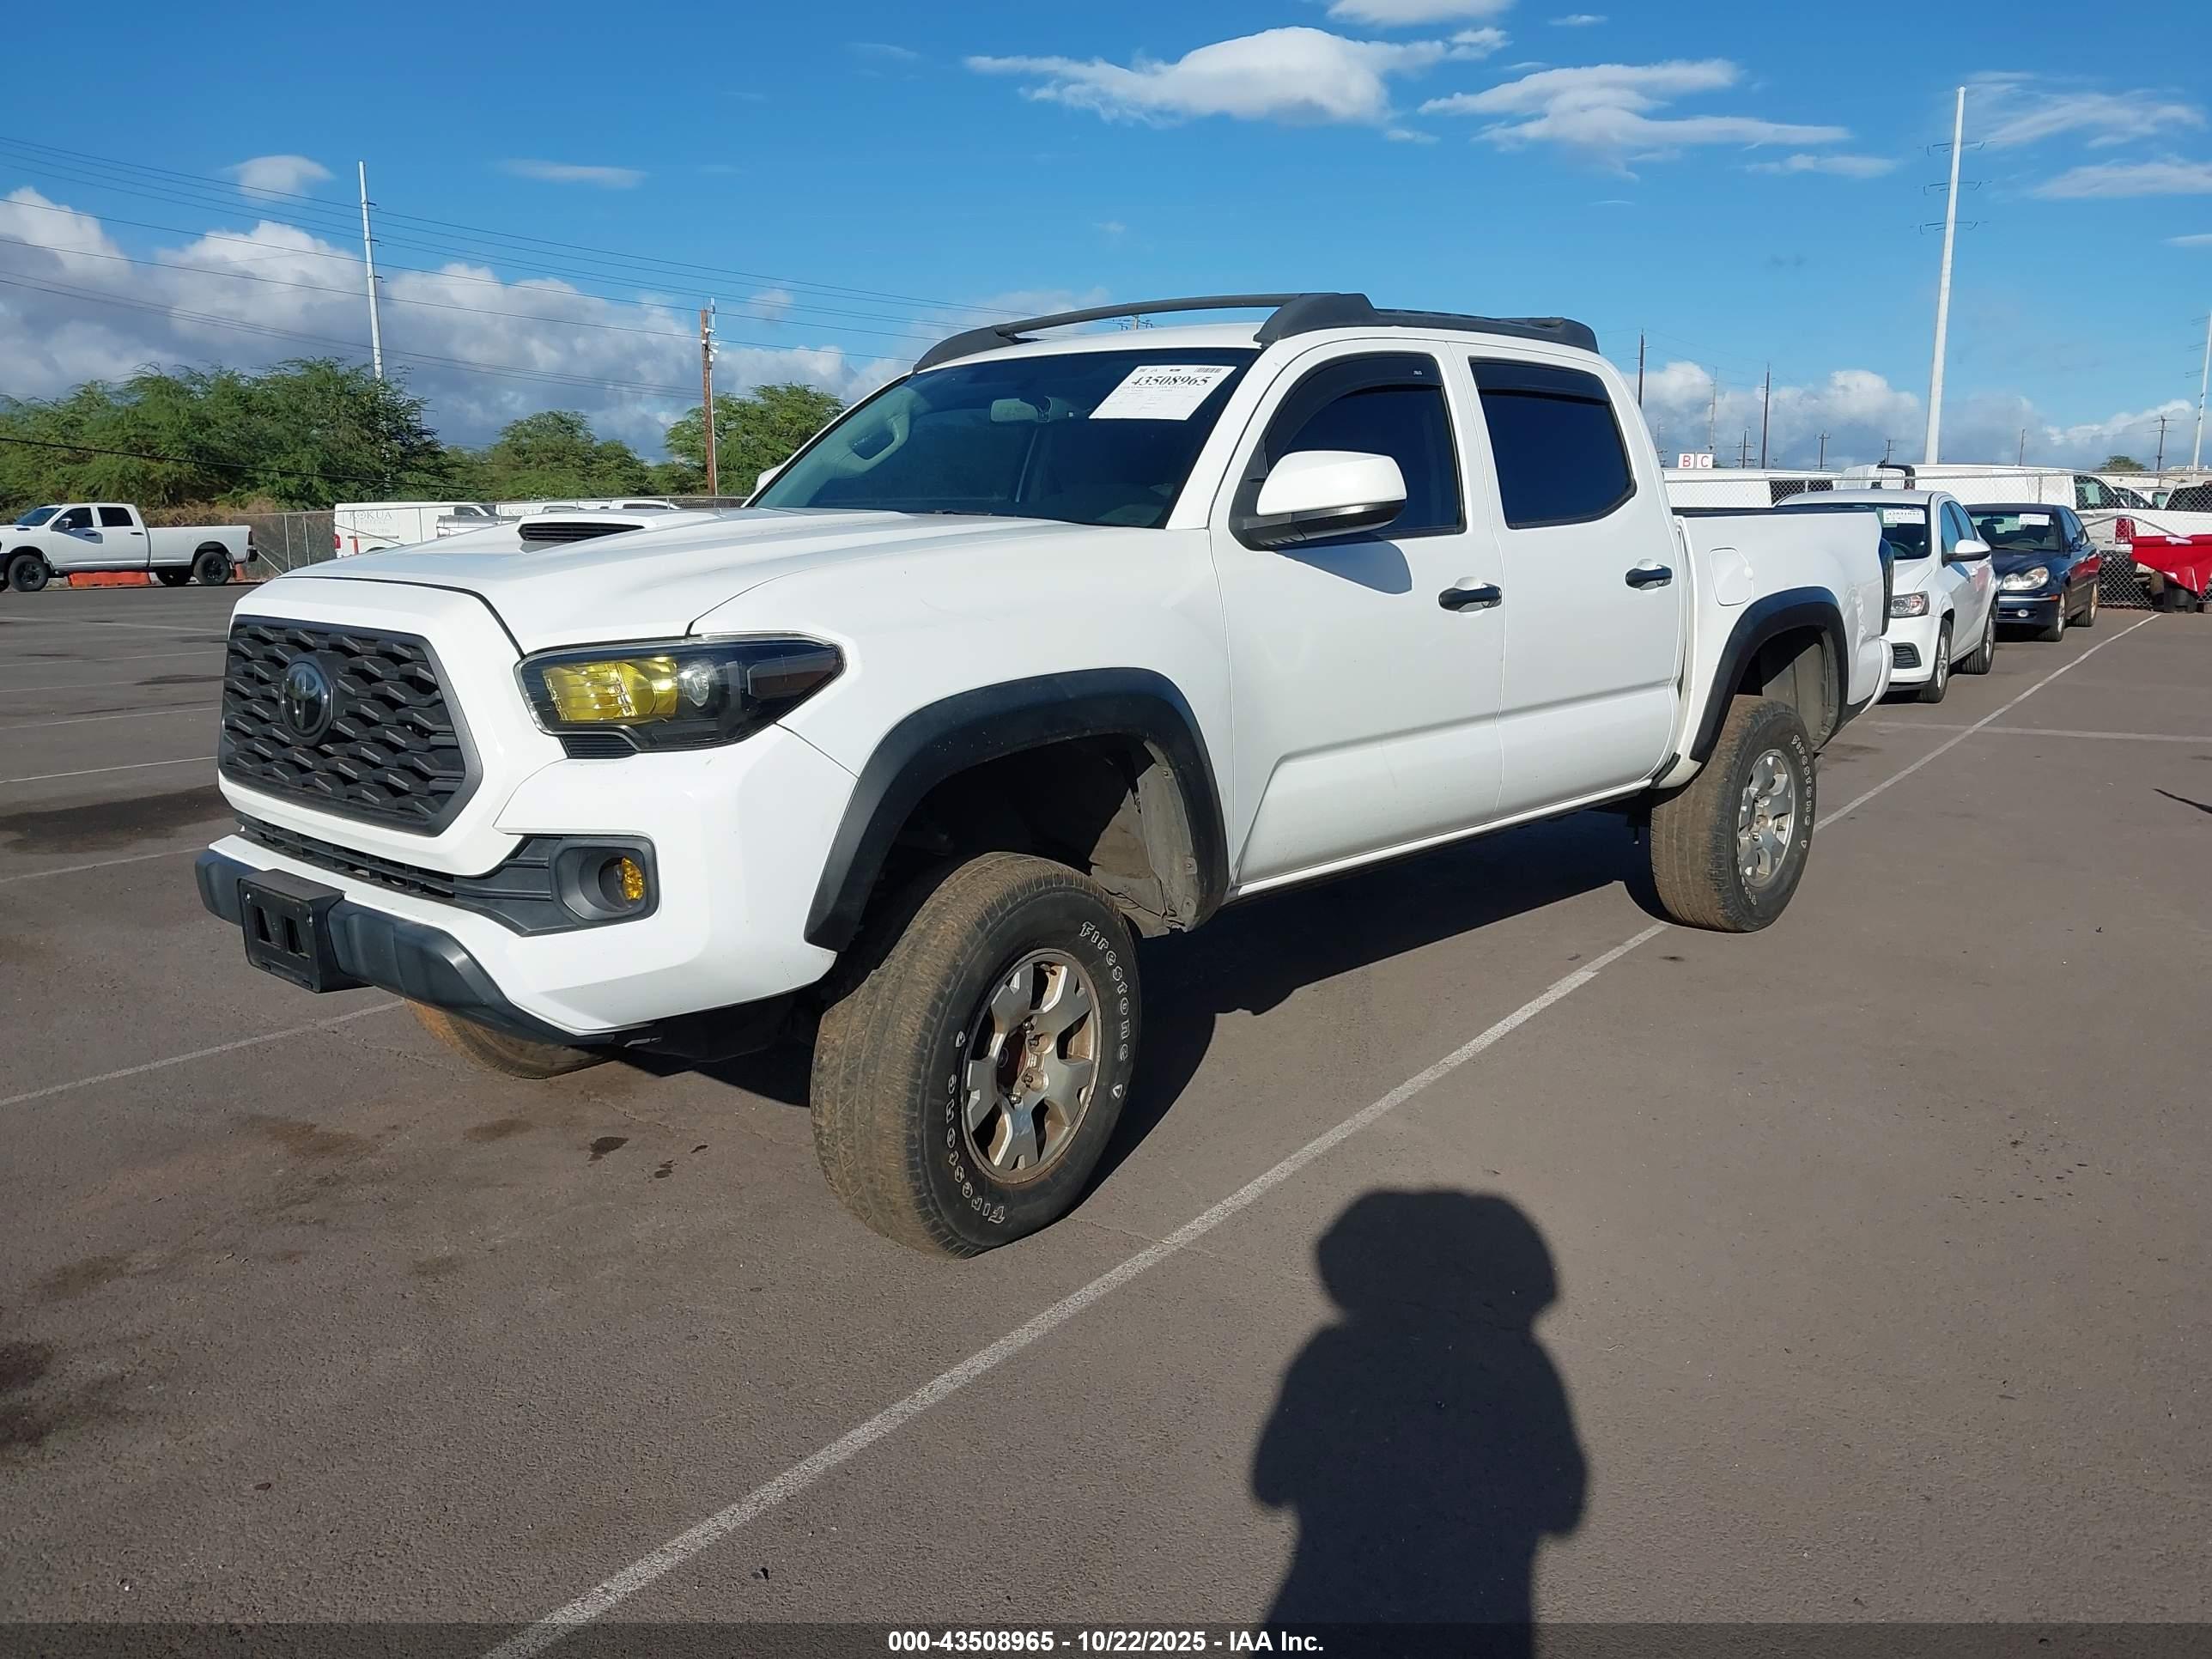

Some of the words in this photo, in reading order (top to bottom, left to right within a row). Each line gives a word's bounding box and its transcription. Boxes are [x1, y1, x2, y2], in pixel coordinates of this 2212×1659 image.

[1132, 376, 1212, 386] 43508965
[1683, 455, 1691, 467] B
[1701, 455, 1709, 467] C
[1791, 734, 1813, 826] Firestone
[1079, 921, 1130, 1062] Firestone
[946, 1073, 1006, 1224] Firestone
